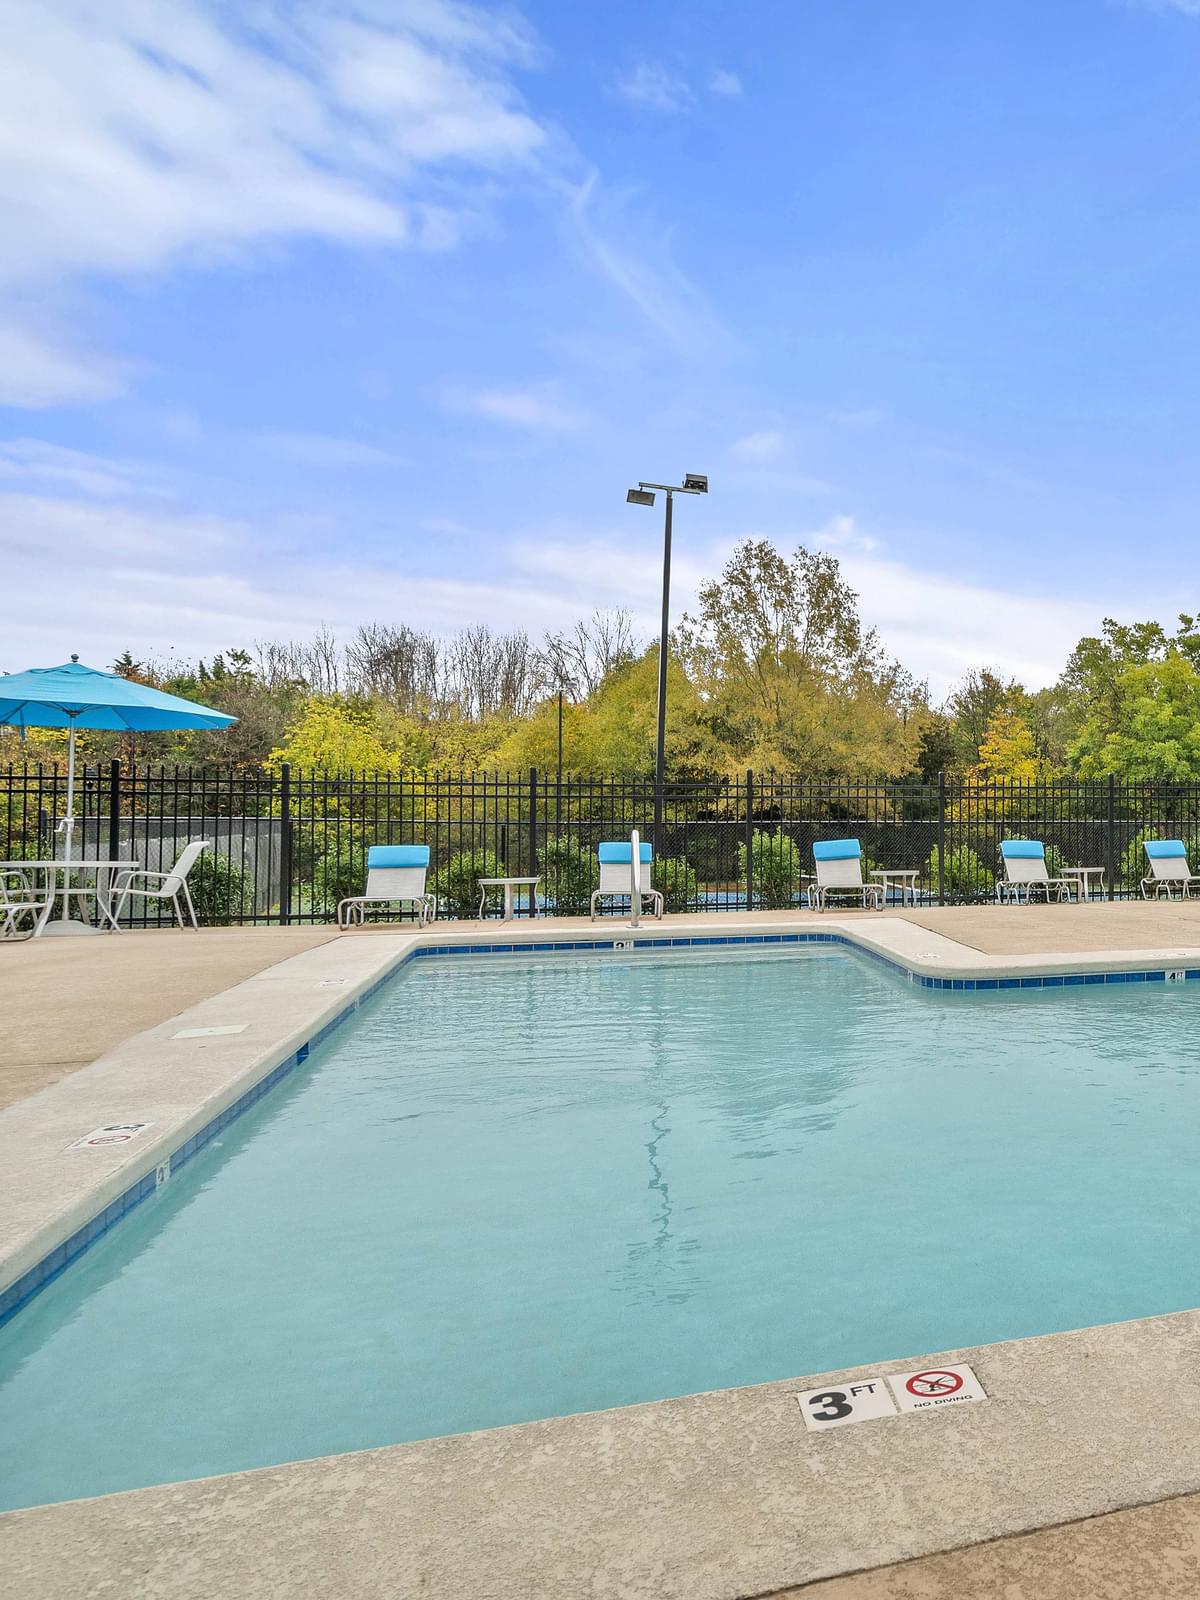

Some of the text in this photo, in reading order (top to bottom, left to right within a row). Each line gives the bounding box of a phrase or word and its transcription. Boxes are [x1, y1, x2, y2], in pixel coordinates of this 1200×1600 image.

[808, 1383, 877, 1422] 3 FT
[914, 1394, 974, 1409] NO DIVING
